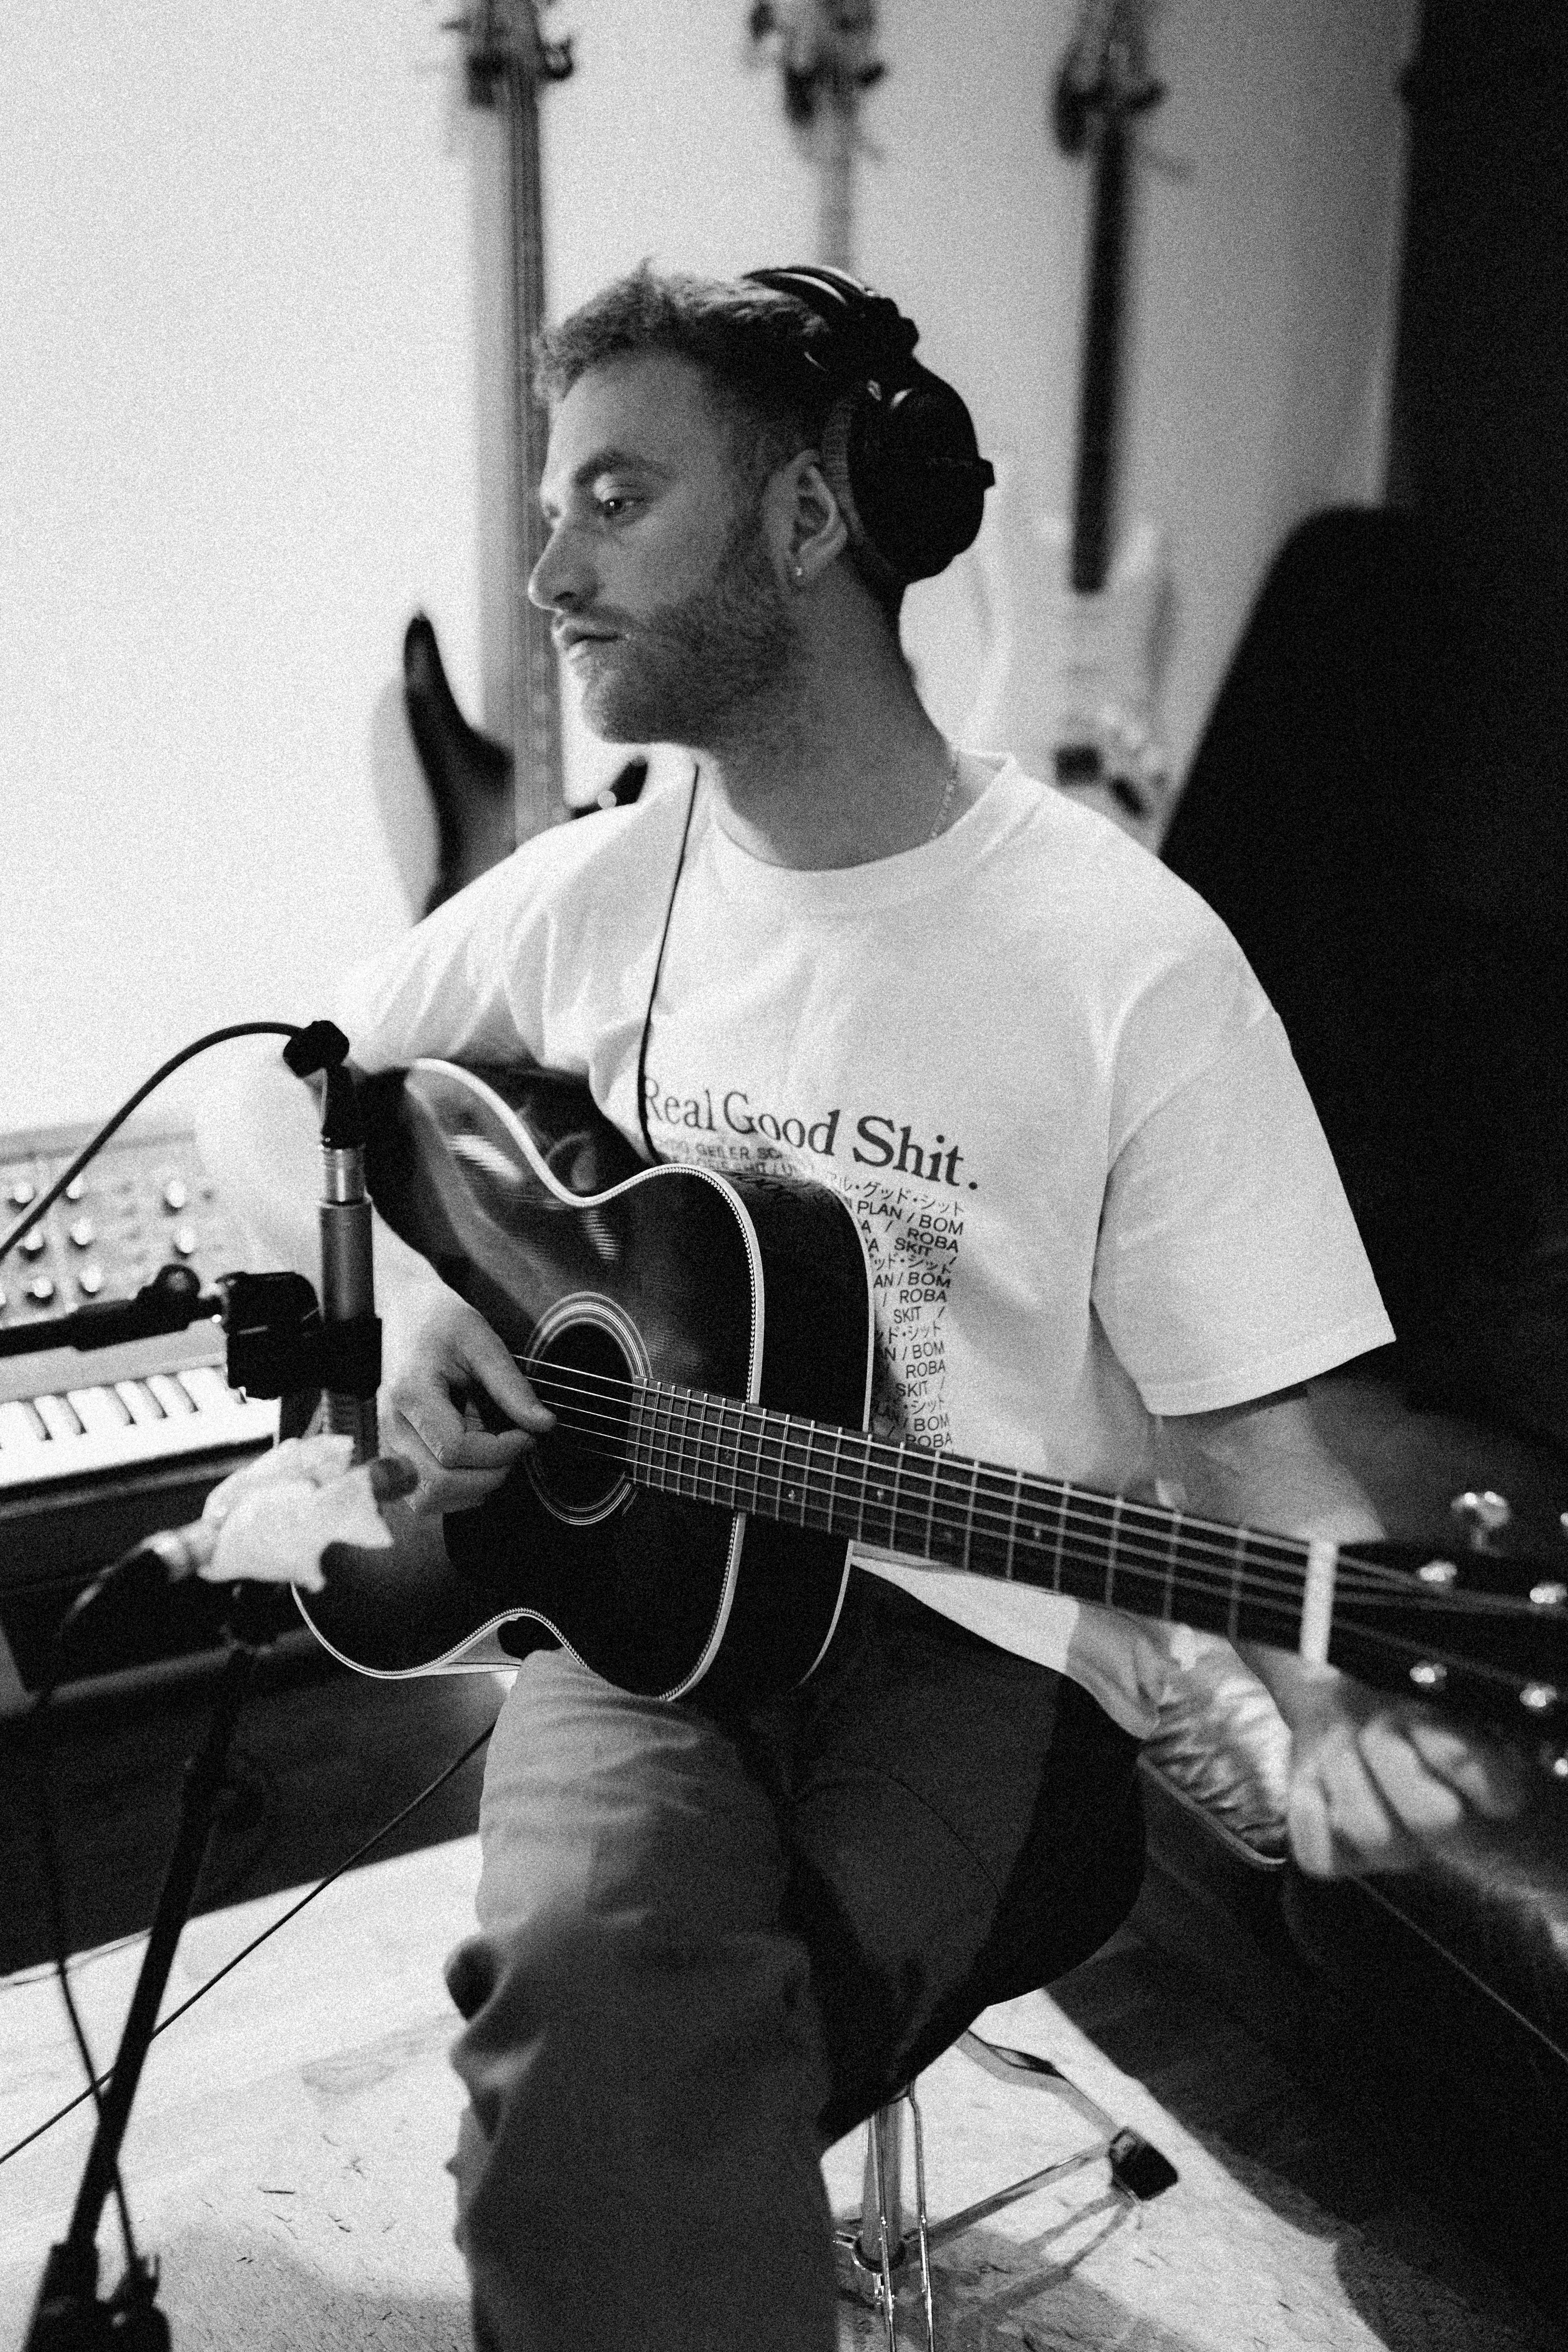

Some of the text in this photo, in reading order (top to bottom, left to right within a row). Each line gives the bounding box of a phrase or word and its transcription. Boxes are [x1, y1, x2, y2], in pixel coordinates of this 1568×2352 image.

[645, 1078, 979, 1190] Real Good Shit.
[857, 1200, 903, 1220] PLAN
[919, 1214, 964, 1235] BOM
[894, 1237, 932, 1256] SKIT
[907, 1227, 959, 1253] ROBA
[908, 1271, 951, 1288] BOM
[900, 1289, 947, 1304] ROBA
[893, 1306, 922, 1324] SKIT
[912, 1341, 945, 1359] BOM
[906, 1359, 946, 1379] ROBA
[896, 1380, 928, 1397] SKIT
[914, 1414, 950, 1432] BOM
